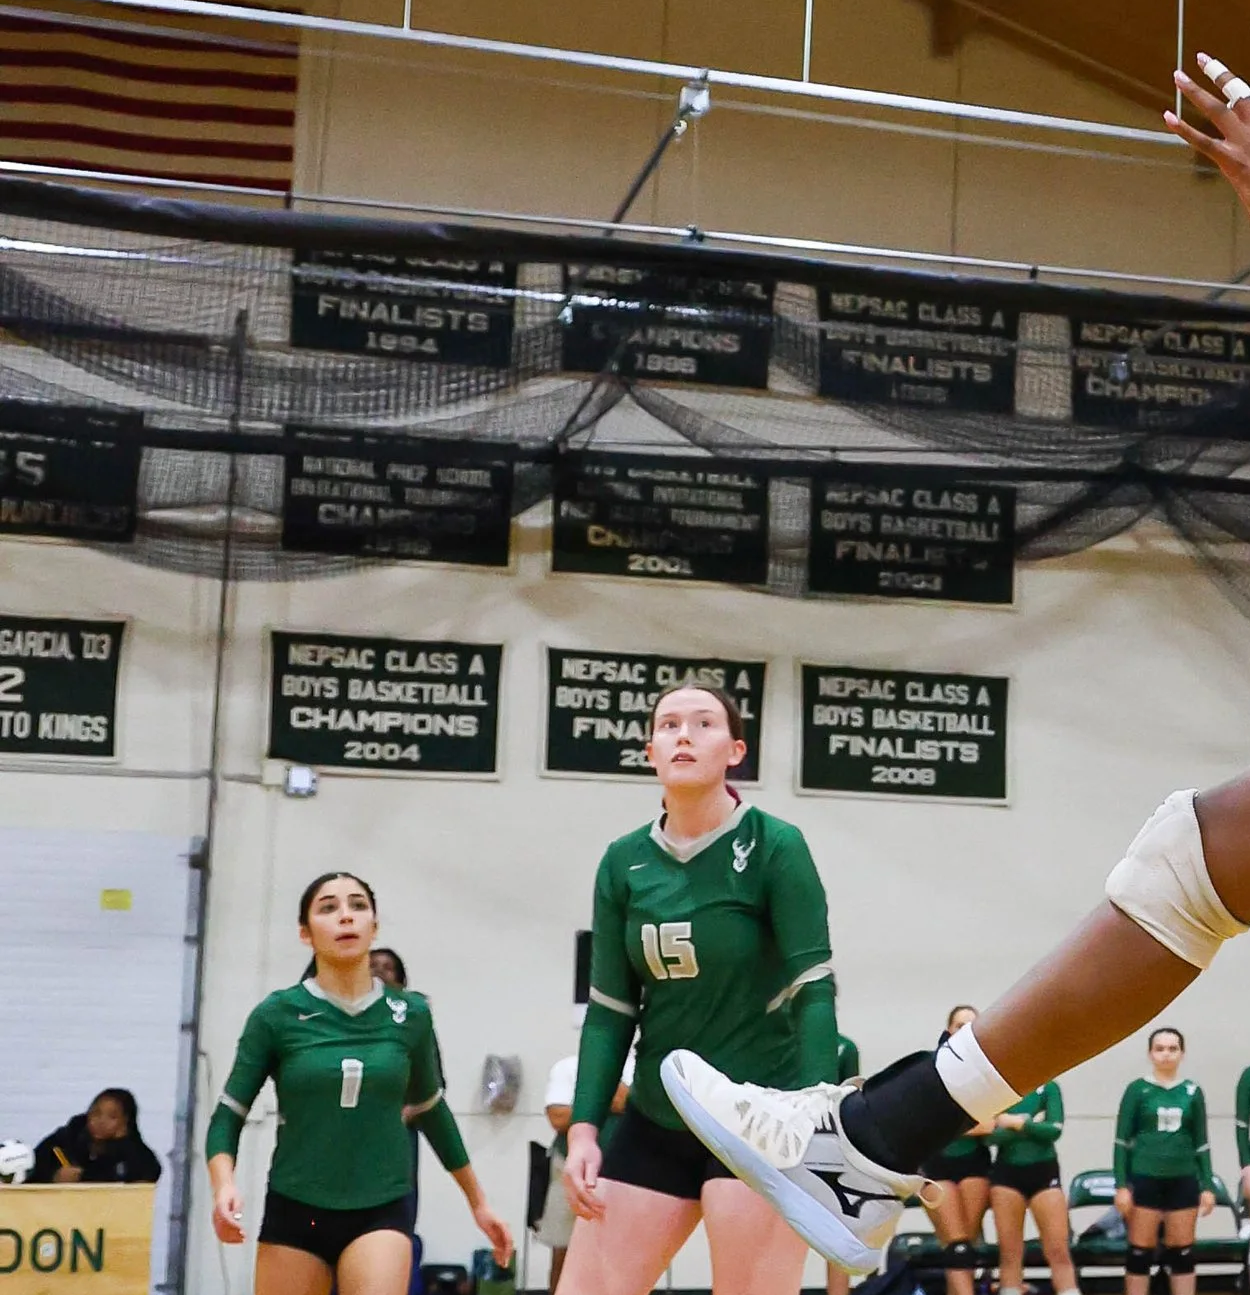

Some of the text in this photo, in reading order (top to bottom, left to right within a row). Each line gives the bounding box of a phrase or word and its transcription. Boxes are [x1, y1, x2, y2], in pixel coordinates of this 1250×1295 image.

[317, 294, 490, 332] FINALISTS
[918, 303, 982, 326] CLASS
[991, 311, 1005, 329] A
[1164, 332, 1224, 354] CLASS
[1232, 339, 1245, 357] A
[841, 349, 992, 382] FINALISTS
[912, 489, 979, 514] CLASS
[987, 495, 1000, 515] A
[820, 509, 999, 542] BOYS BASKETBALL
[288, 644, 485, 675] NEPSAC CLASS A
[562, 658, 750, 690] NEPSAC CLASS A
[281, 674, 488, 706] BOYS BASKETBALL
[555, 686, 611, 710] BOYS
[819, 677, 990, 706] NEPSAC CLASS A
[38, 712, 108, 742] KINGS
[290, 707, 479, 737] CHAMPIONS
[813, 705, 995, 735] BOYS BASKETBALL
[344, 741, 421, 762] 2004
[829, 734, 979, 763] FINALISTS
[871, 766, 936, 786] 2008
[641, 921, 699, 980] 15
[340, 1058, 365, 1108] 1
